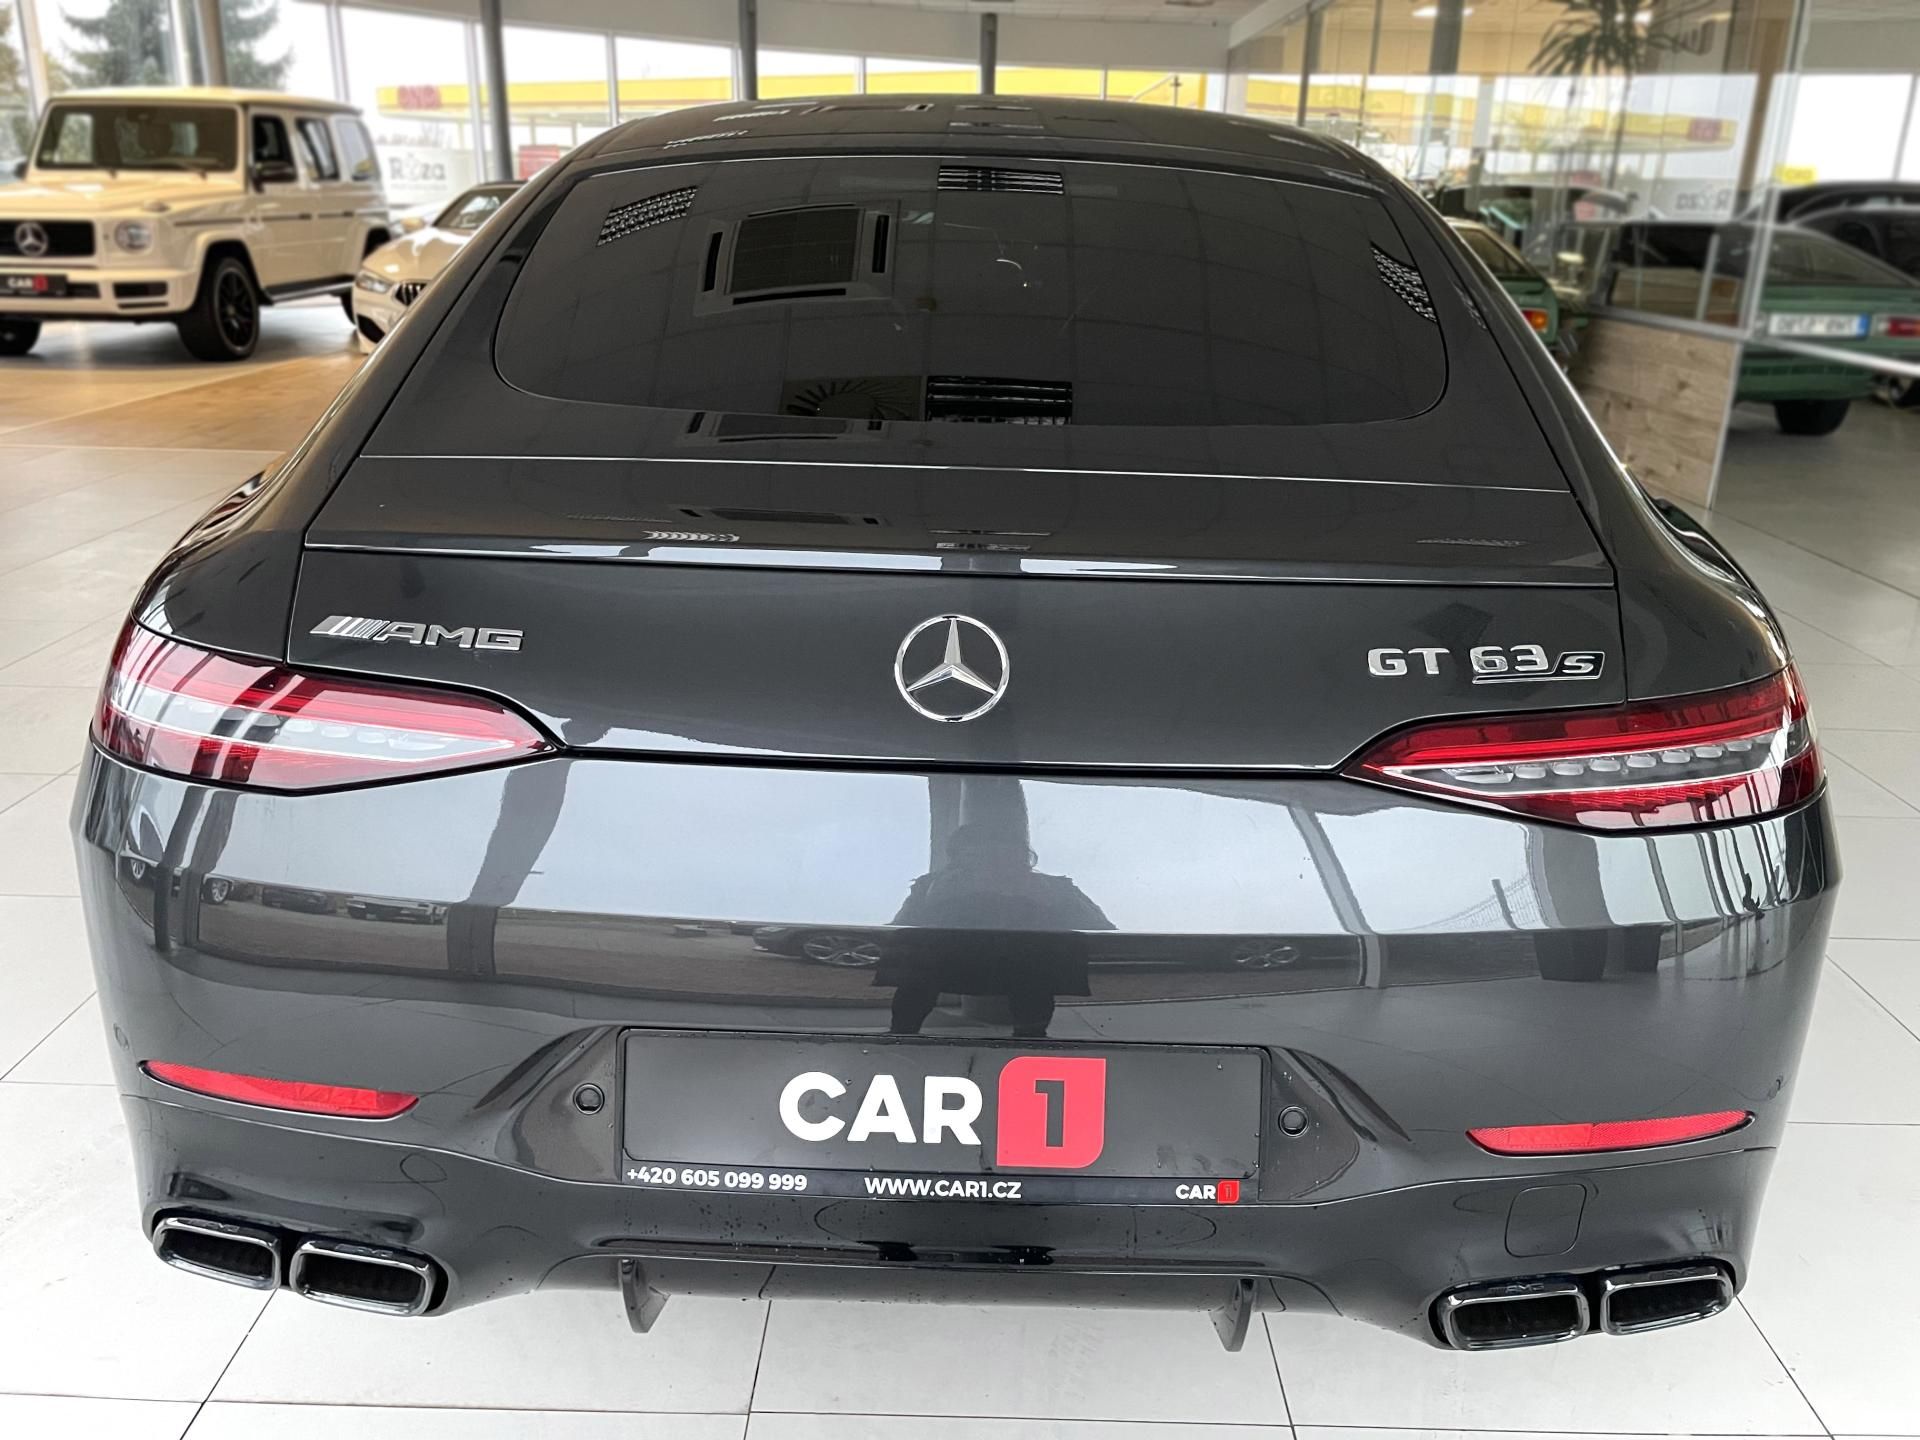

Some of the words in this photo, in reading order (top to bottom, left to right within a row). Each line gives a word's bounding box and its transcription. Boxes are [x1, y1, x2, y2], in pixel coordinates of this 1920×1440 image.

[373, 621, 523, 650] AMG
[1368, 648, 1450, 676] GT
[627, 1166, 676, 1184] +420
[681, 1169, 720, 1187] 605
[724, 1171, 764, 1189] 099
[768, 1173, 807, 1191] 999
[864, 1177, 1022, 1199] WWW.CAR1.CZ
